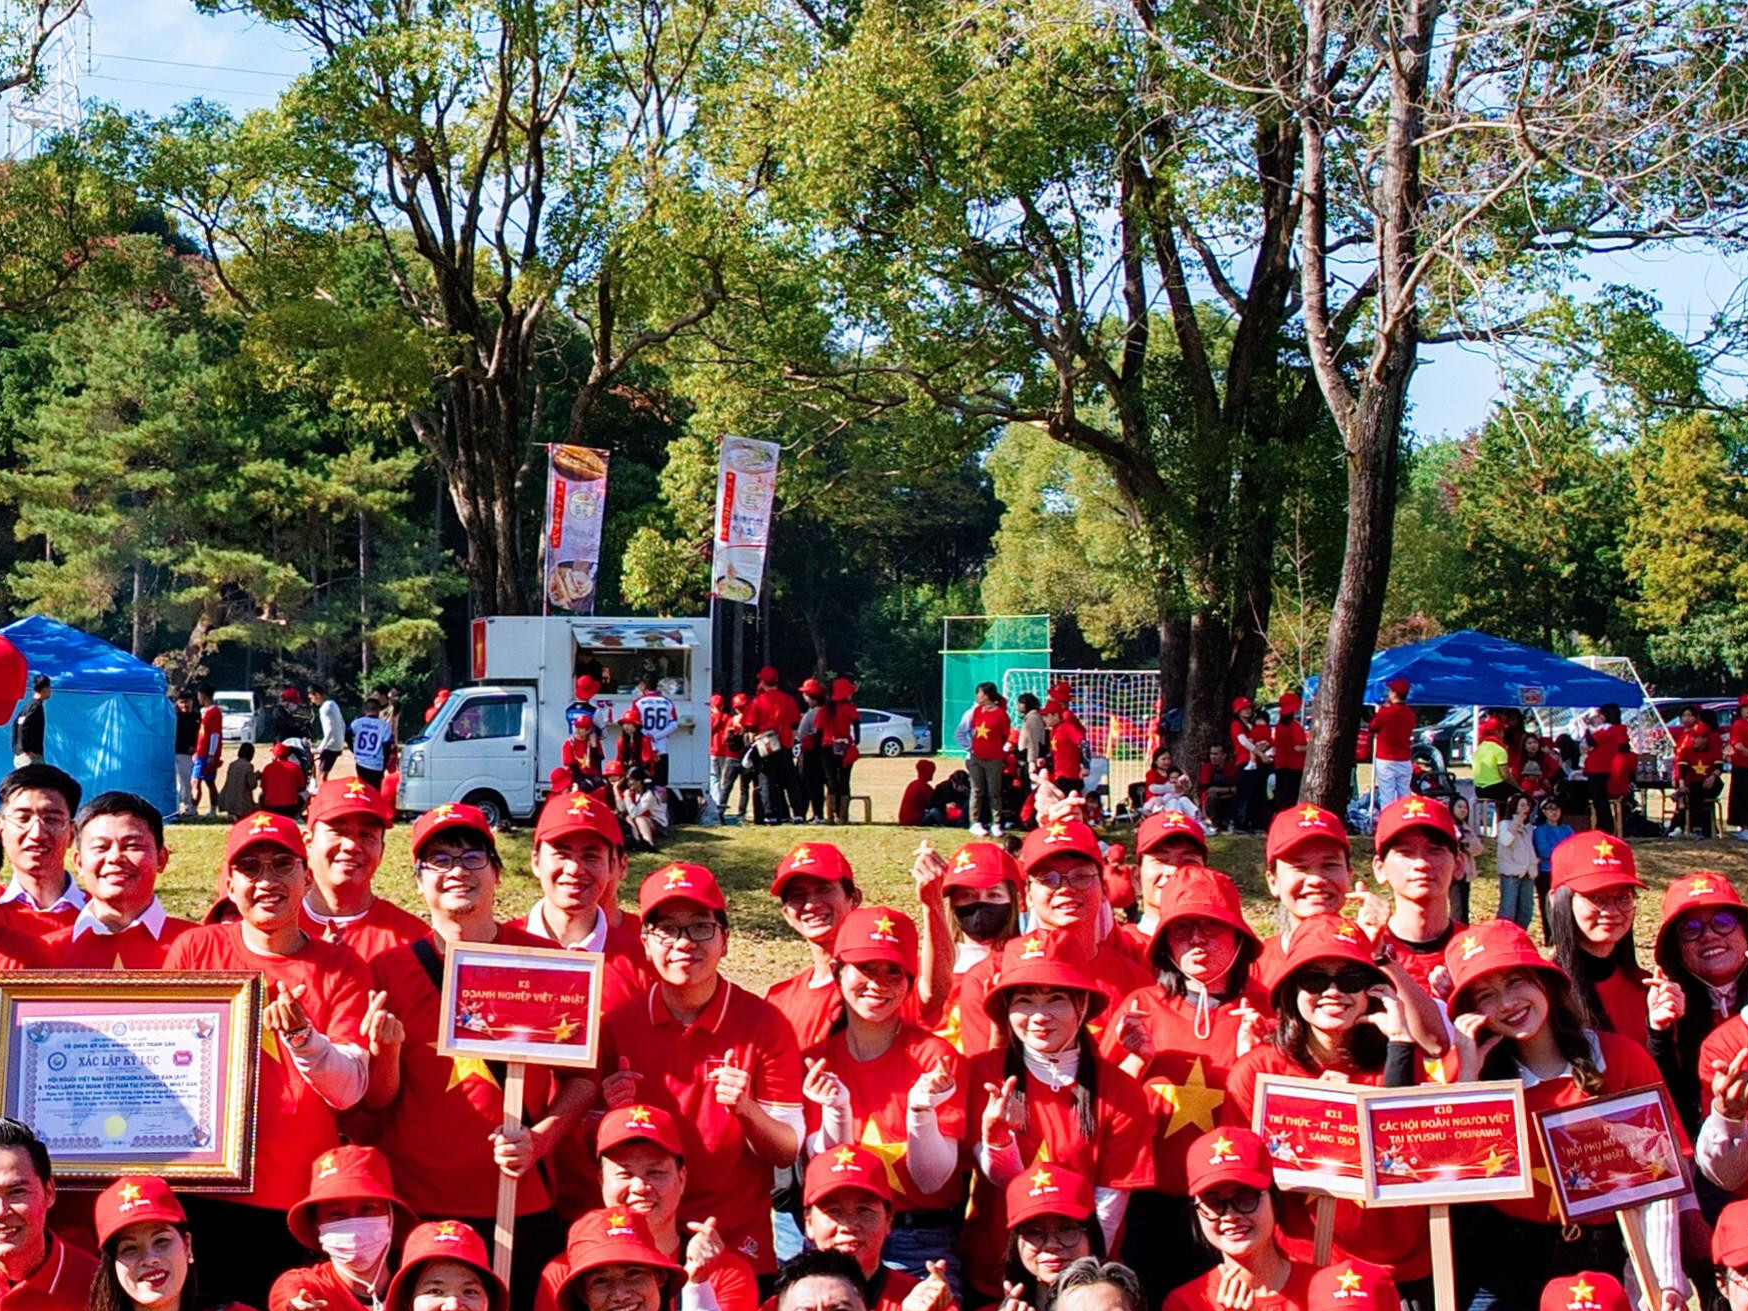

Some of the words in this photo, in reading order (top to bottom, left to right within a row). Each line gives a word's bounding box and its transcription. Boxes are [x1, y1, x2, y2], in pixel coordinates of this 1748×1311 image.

[643, 706, 667, 731] 66
[357, 730, 378, 752] 69
[1378, 1119, 1400, 1132] CÁC
[1406, 1131, 1447, 1144] KYUSHU
[1453, 1128, 1503, 1141] OKINAWA
